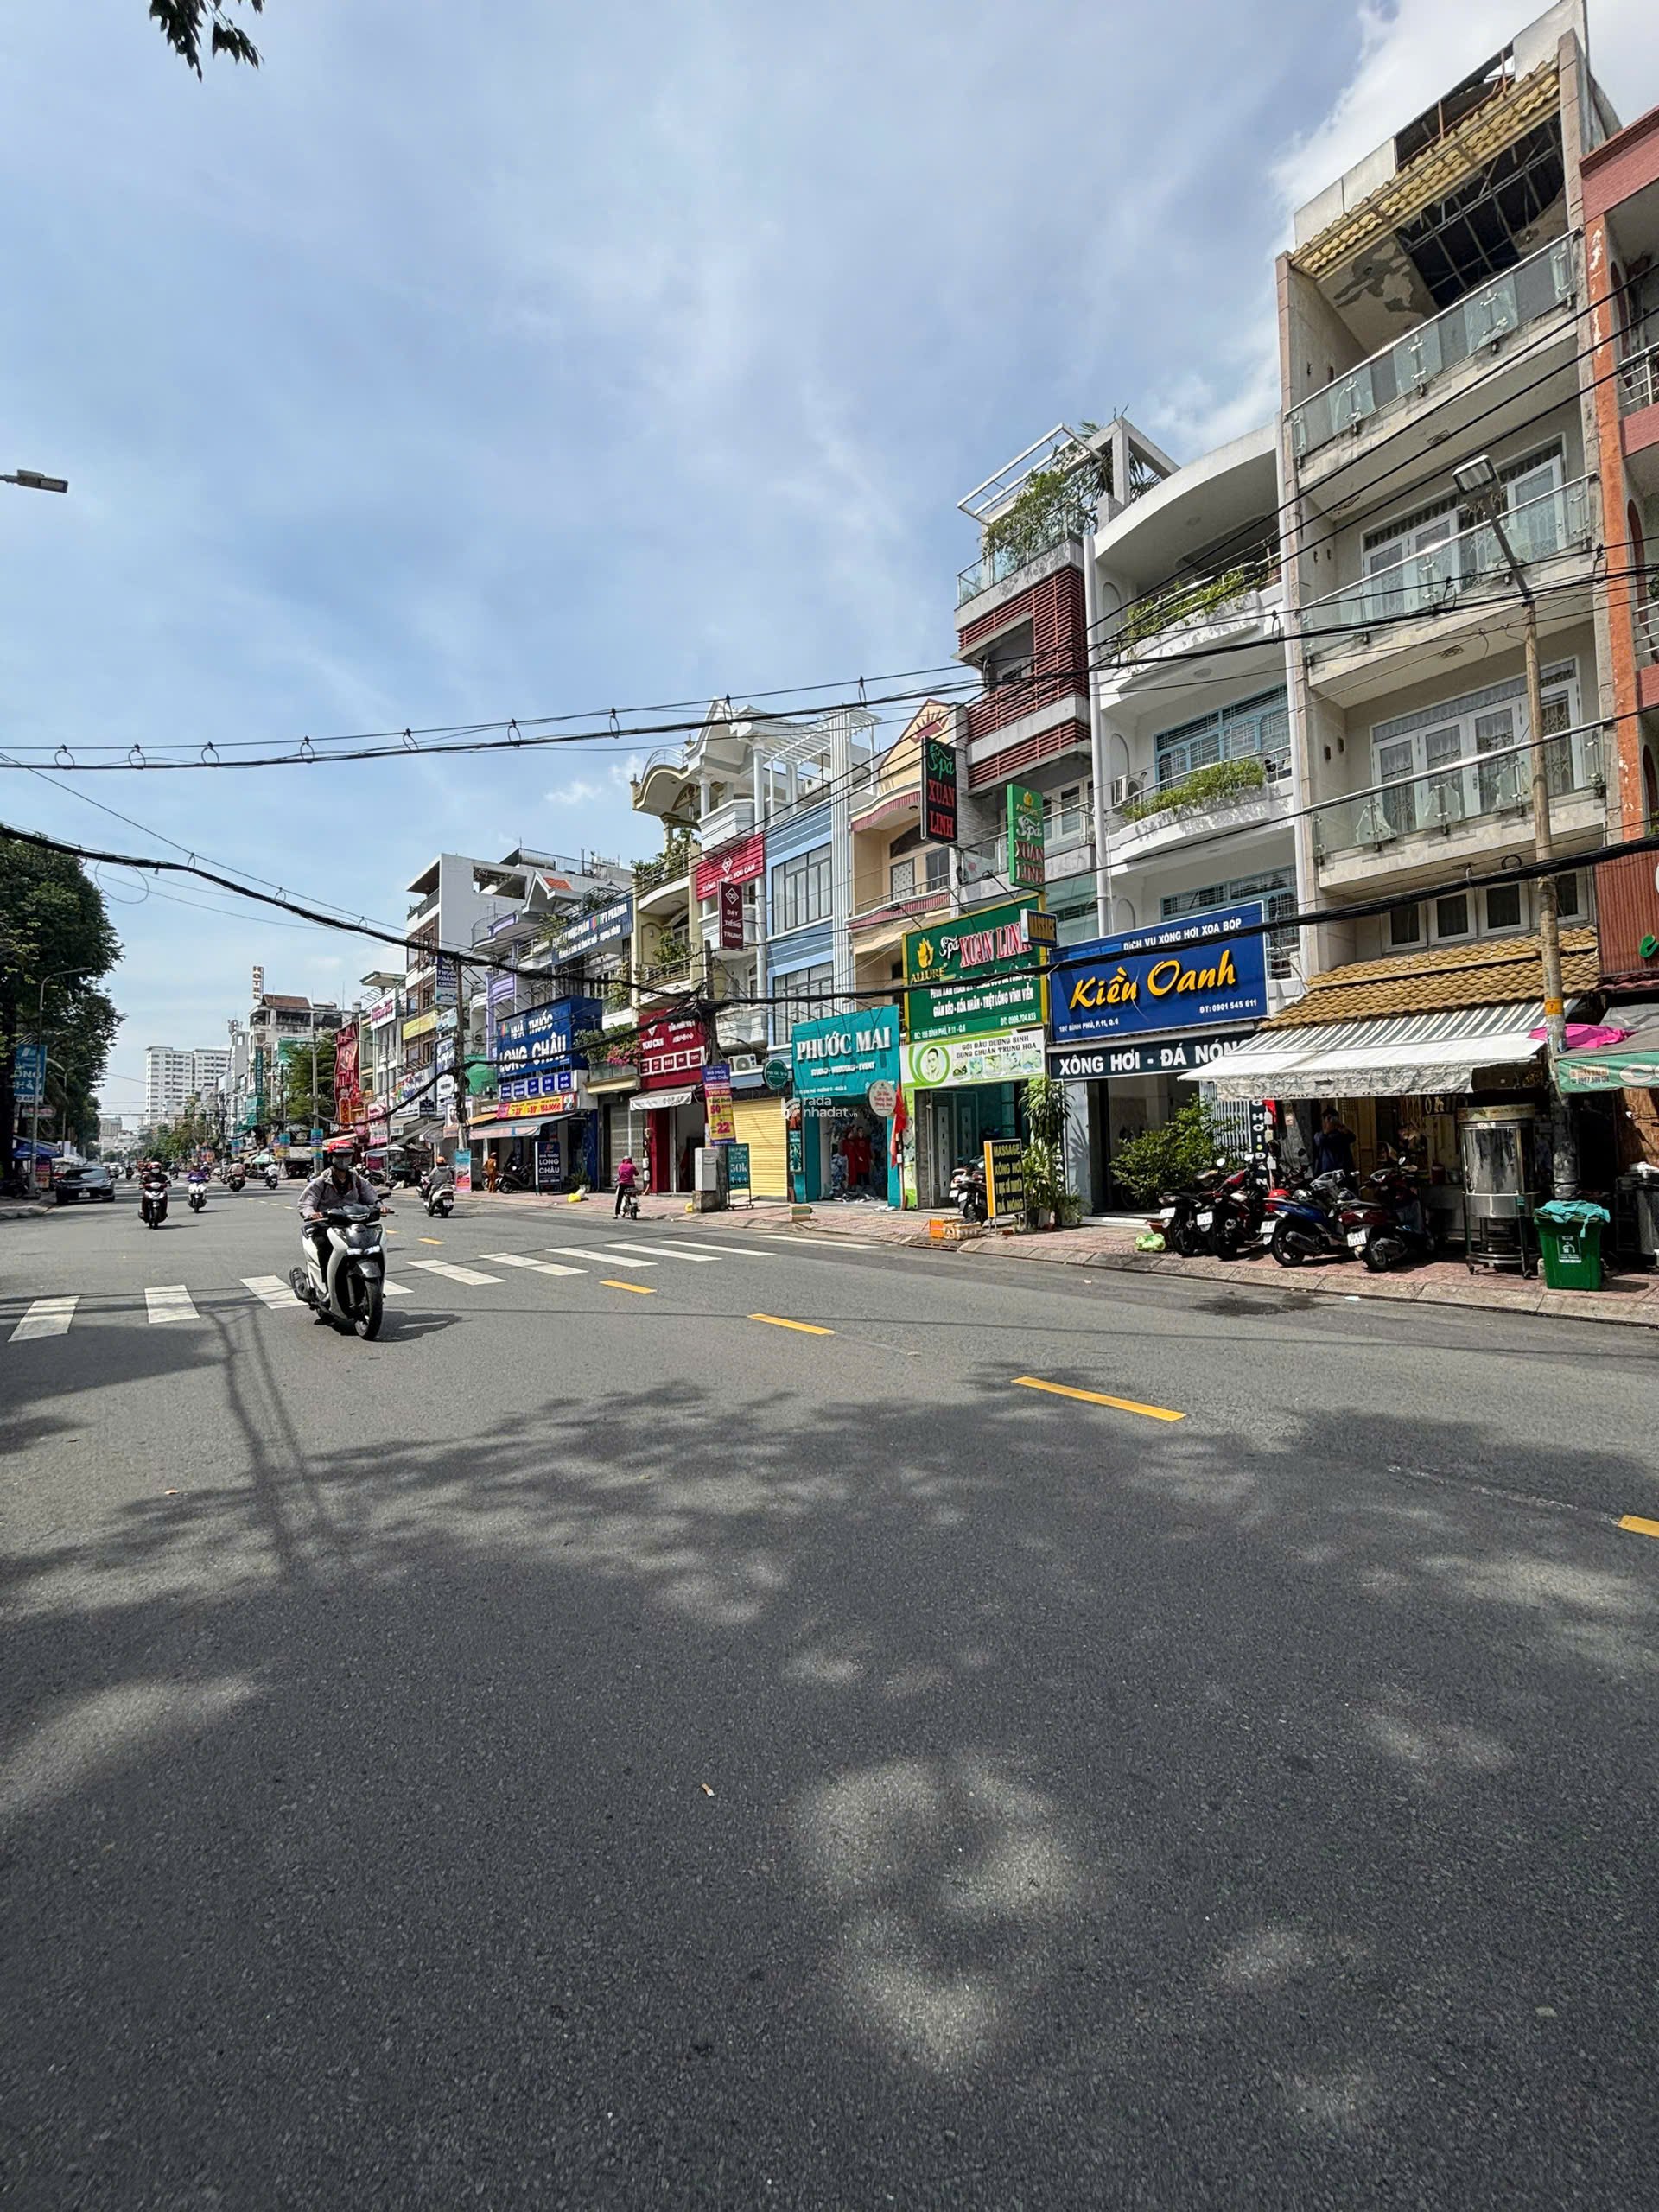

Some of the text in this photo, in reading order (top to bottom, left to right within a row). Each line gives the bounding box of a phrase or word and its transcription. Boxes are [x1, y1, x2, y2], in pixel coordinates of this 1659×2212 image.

[928, 744, 954, 779] Spa
[929, 779, 955, 809] XUAN
[930, 810, 954, 838] LINH
[1016, 816, 1042, 841] Spa
[1014, 840, 1044, 863] XUAN
[1202, 922, 1221, 936] XOA
[939, 935, 959, 959] Spa
[253, 966, 262, 1000] HOTEL
[910, 966, 945, 984] ALLURE
[1069, 966, 1138, 1010] Kiều
[1147, 949, 1236, 997] Oanh
[1212, 1003, 1228, 1012] 0901
[1230, 1001, 1243, 1009] 545
[1245, 999, 1257, 1007] 611
[796, 1026, 892, 1061] PHƯỚC MAI
[997, 1044, 1020, 1054] TRUNG
[1058, 1055, 1104, 1076] XÔNG
[1110, 1050, 1141, 1071] HƠI
[1160, 1044, 1187, 1068] ĐÁ
[538, 1166, 560, 1174] CHÂU
